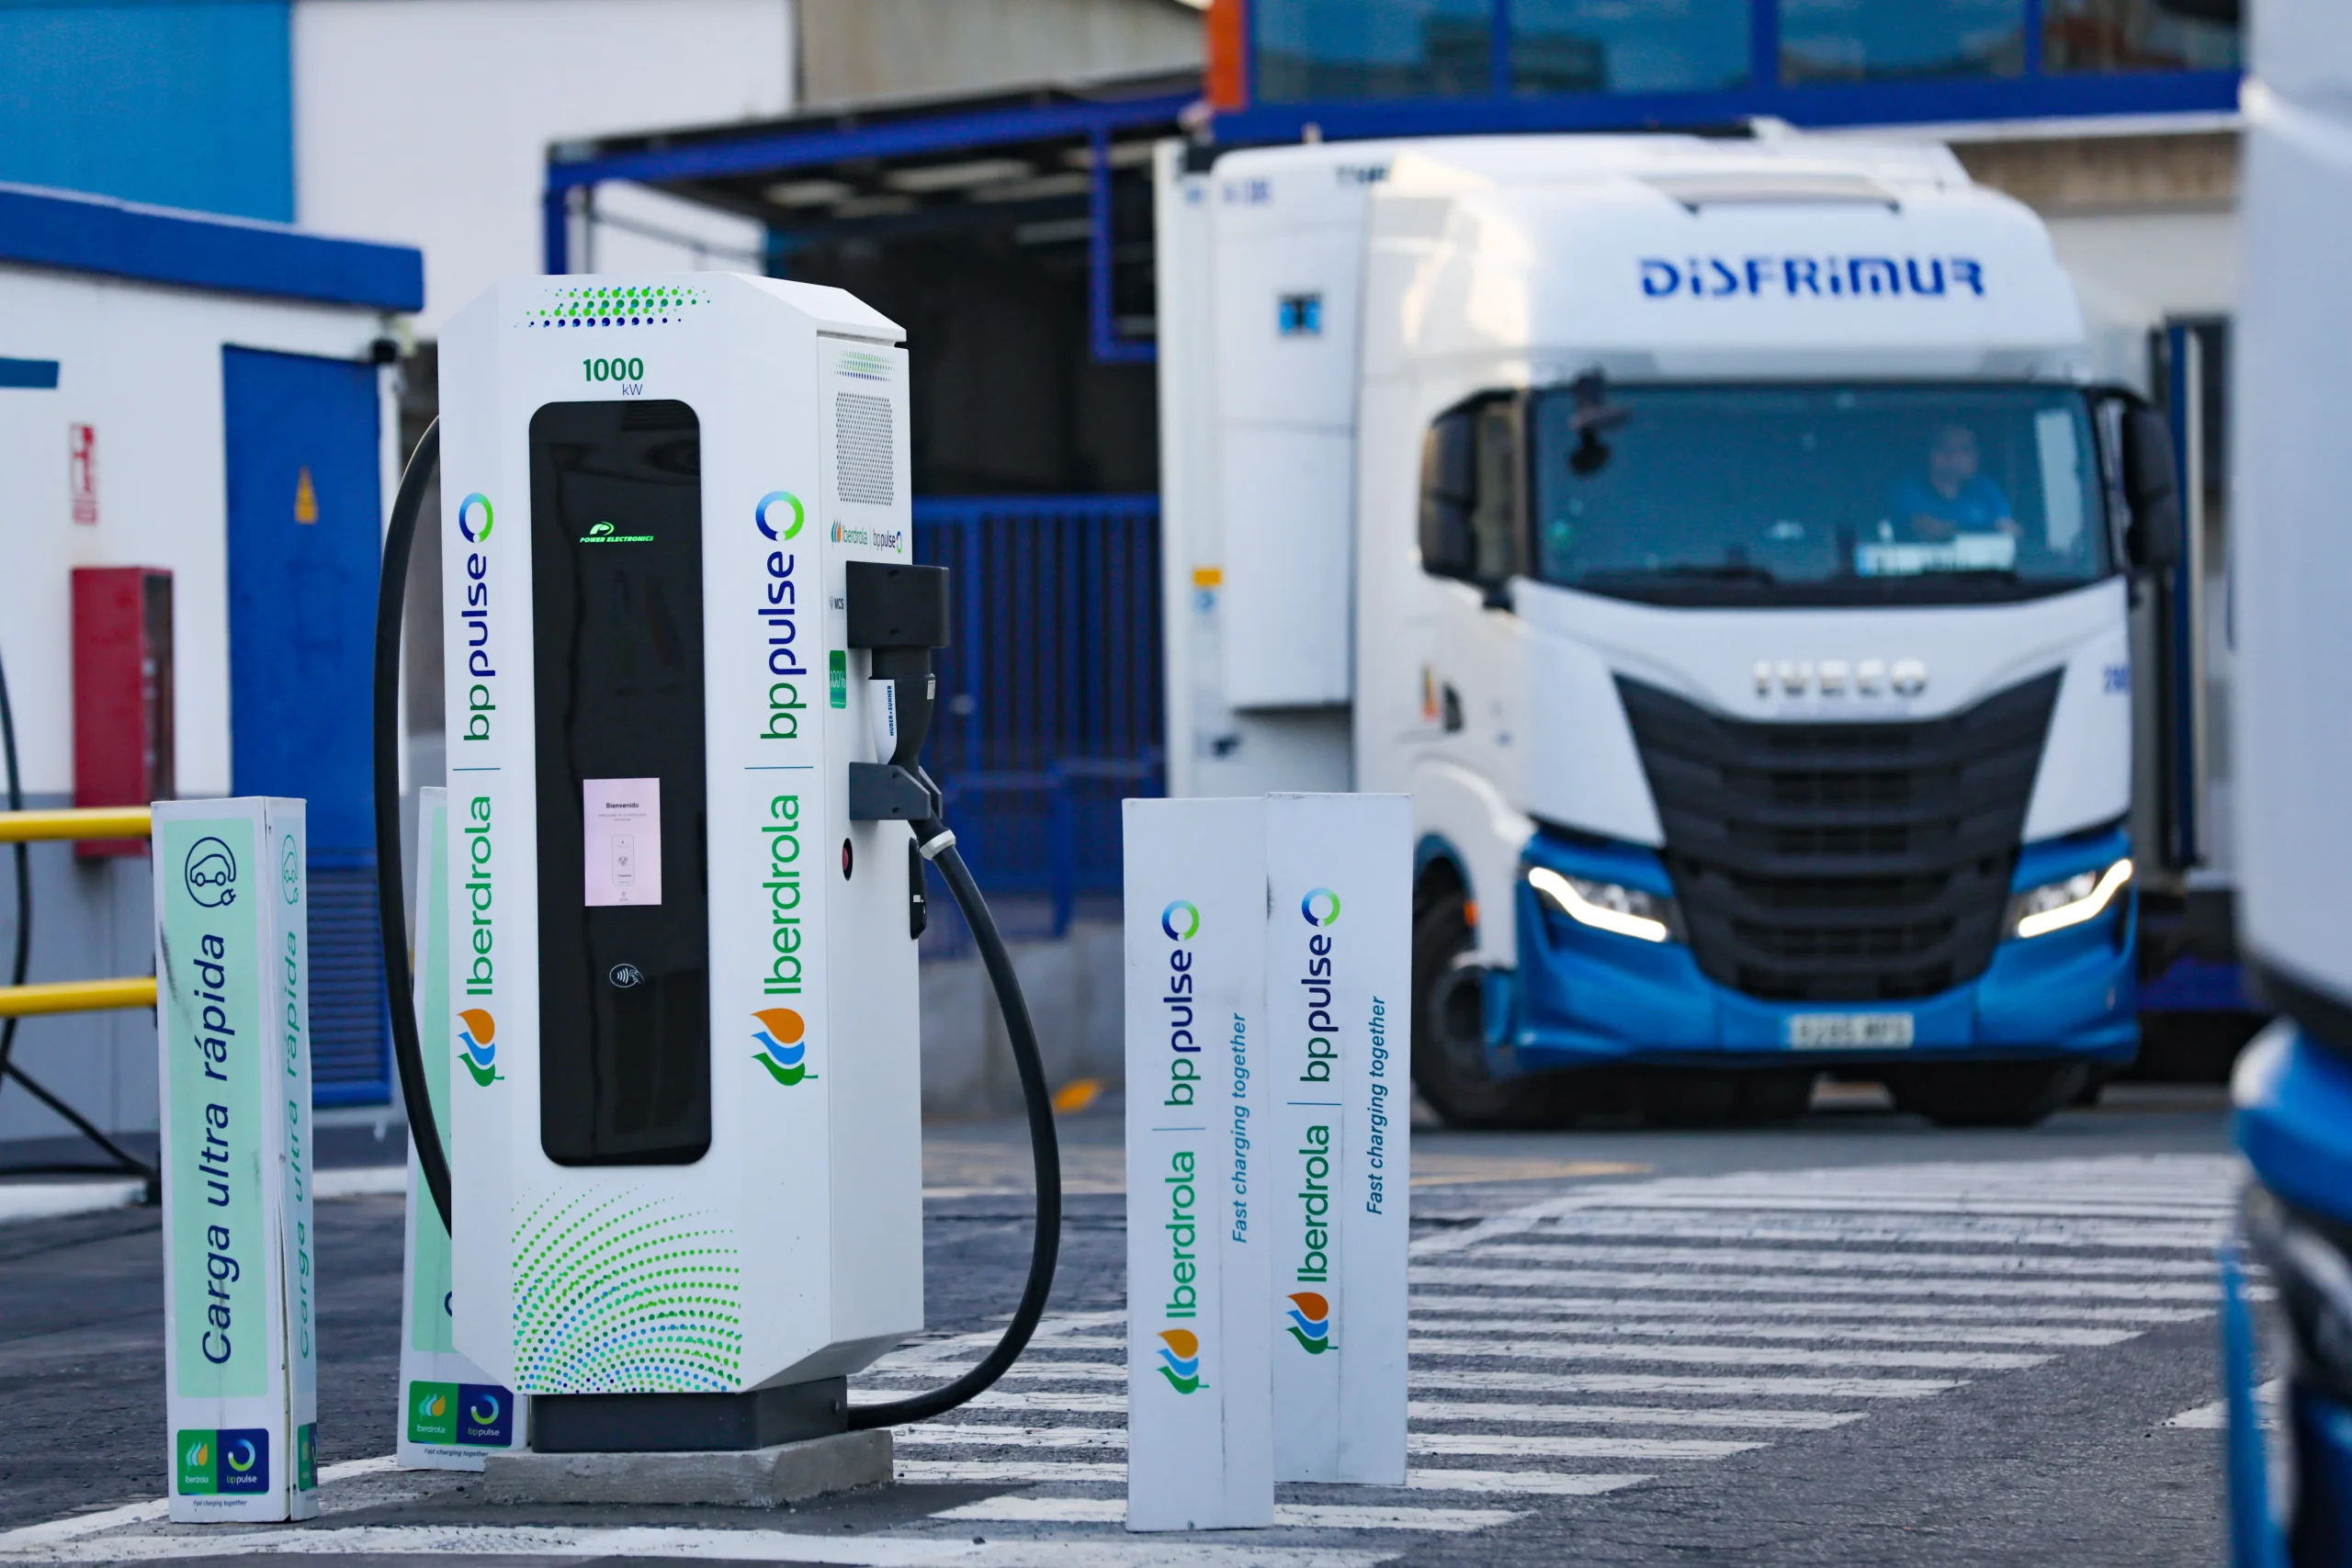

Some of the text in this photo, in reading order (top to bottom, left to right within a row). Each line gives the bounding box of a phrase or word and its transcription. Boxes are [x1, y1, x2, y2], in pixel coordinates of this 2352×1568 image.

[582, 357, 644, 382] 1000
[622, 383, 643, 396] kW
[842, 525, 868, 545] Iberdrola
[834, 598, 844, 610] MCS
[830, 671, 845, 689] 100%
[464, 796, 493, 996] Iberdrola
[761, 795, 802, 995] Iberdrola
[1366, 995, 1389, 1215] Fast charging together
[1229, 1012, 1250, 1244] Fast charging together
[193, 933, 240, 1365] Carga ultra rápida
[284, 931, 310, 1359] Carga ultra rápida
[1296, 1125, 1329, 1282] Iberdrola
[1164, 1151, 1196, 1318] Iberdrola
[416, 1424, 447, 1434] Iberdrola
[435, 1449, 462, 1457] charging
[463, 1450, 489, 1458] together
[185, 1475, 209, 1484] Iberdrola
[203, 1499, 222, 1507] charging
